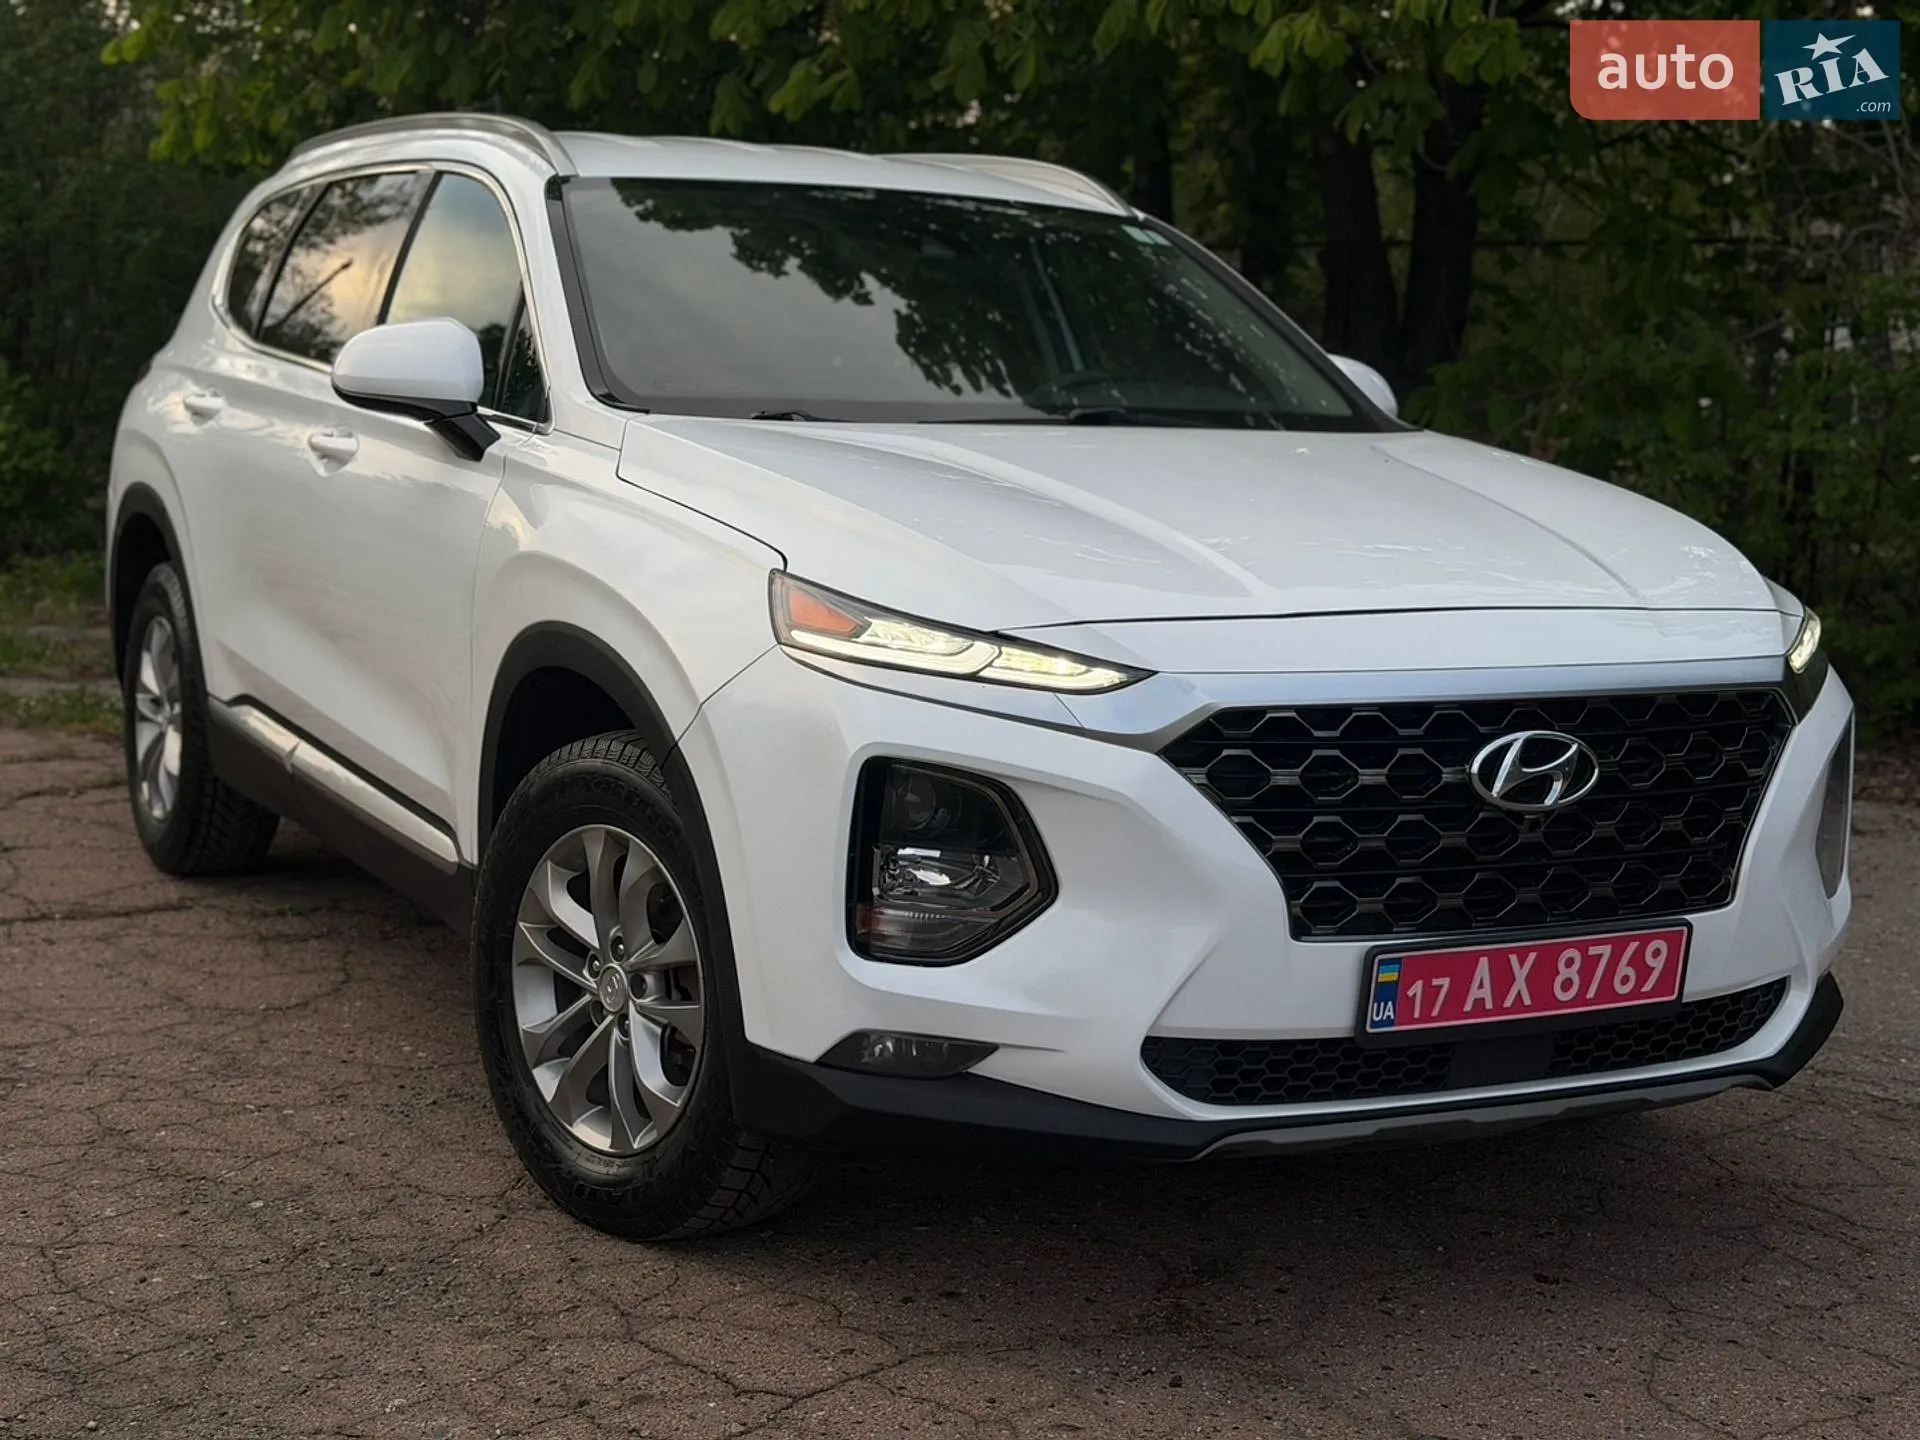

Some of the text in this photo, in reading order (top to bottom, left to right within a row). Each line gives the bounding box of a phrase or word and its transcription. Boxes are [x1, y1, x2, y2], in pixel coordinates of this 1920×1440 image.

[1406, 939, 1668, 1019] 17 AX 8769
[1372, 1001, 1395, 1021] UA
